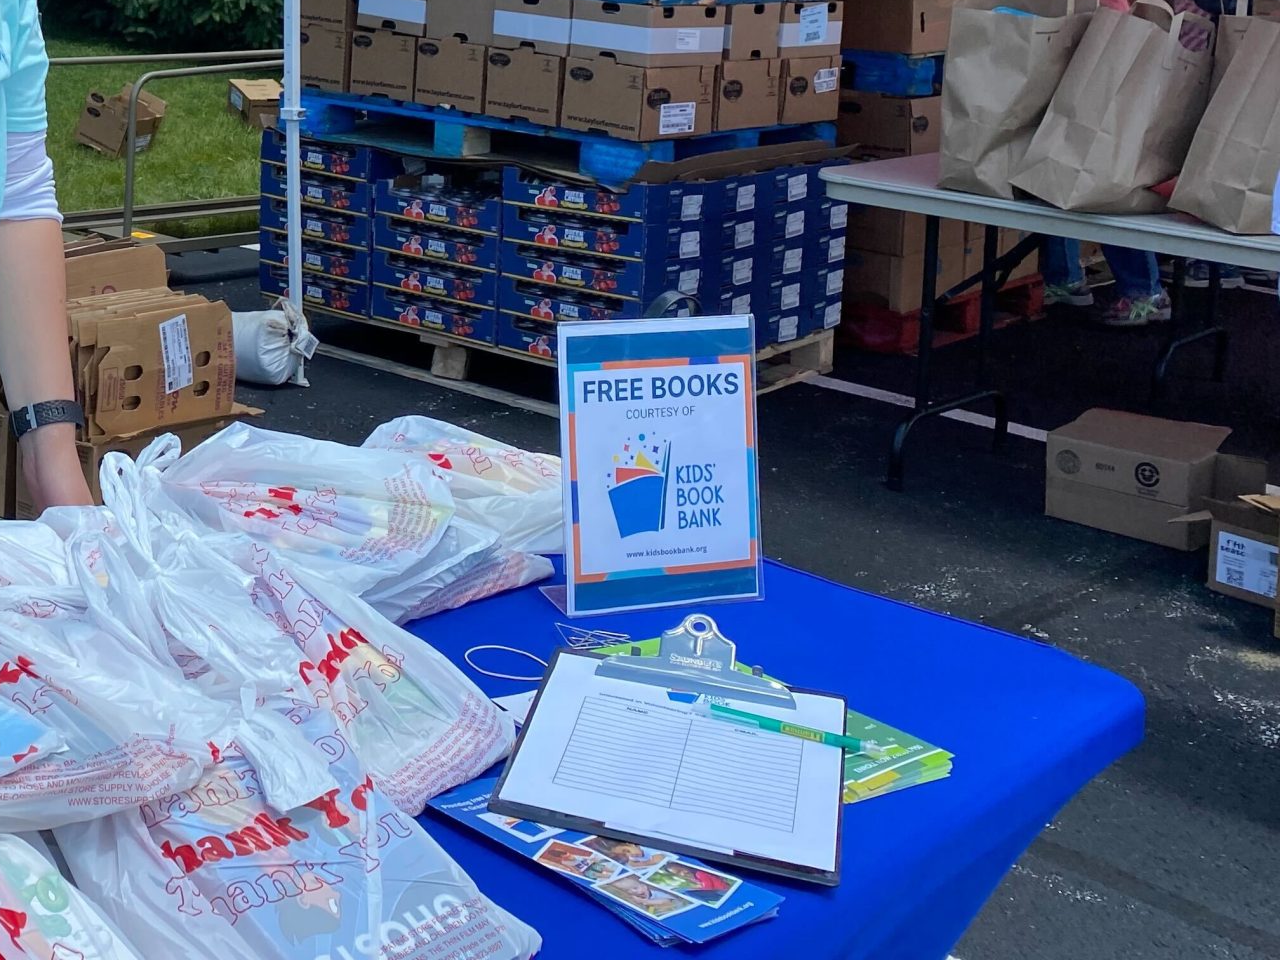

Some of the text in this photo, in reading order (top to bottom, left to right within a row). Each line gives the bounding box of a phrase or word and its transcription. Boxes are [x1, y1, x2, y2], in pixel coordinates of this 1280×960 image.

[417, 88, 476, 101] www.taylorfarms.com
[487, 99, 550, 115] www.taylorfarms.com
[567, 114, 636, 133] www.taylorfarms.com
[582, 372, 739, 403] FREE BOOKS
[626, 405, 696, 420] COURTESY OF
[675, 463, 717, 483] KIDS'
[676, 485, 724, 507] BOOK
[678, 507, 722, 530] BANK
[626, 545, 708, 559] www.kidsbookbank.org
[47, 780, 65, 788] AND
[68, 785, 98, 794] STORE
[98, 784, 133, 793] SUPPLY
[408, 922, 433, 937] STORE
[428, 919, 490, 957] THE THIN FILM MAY
